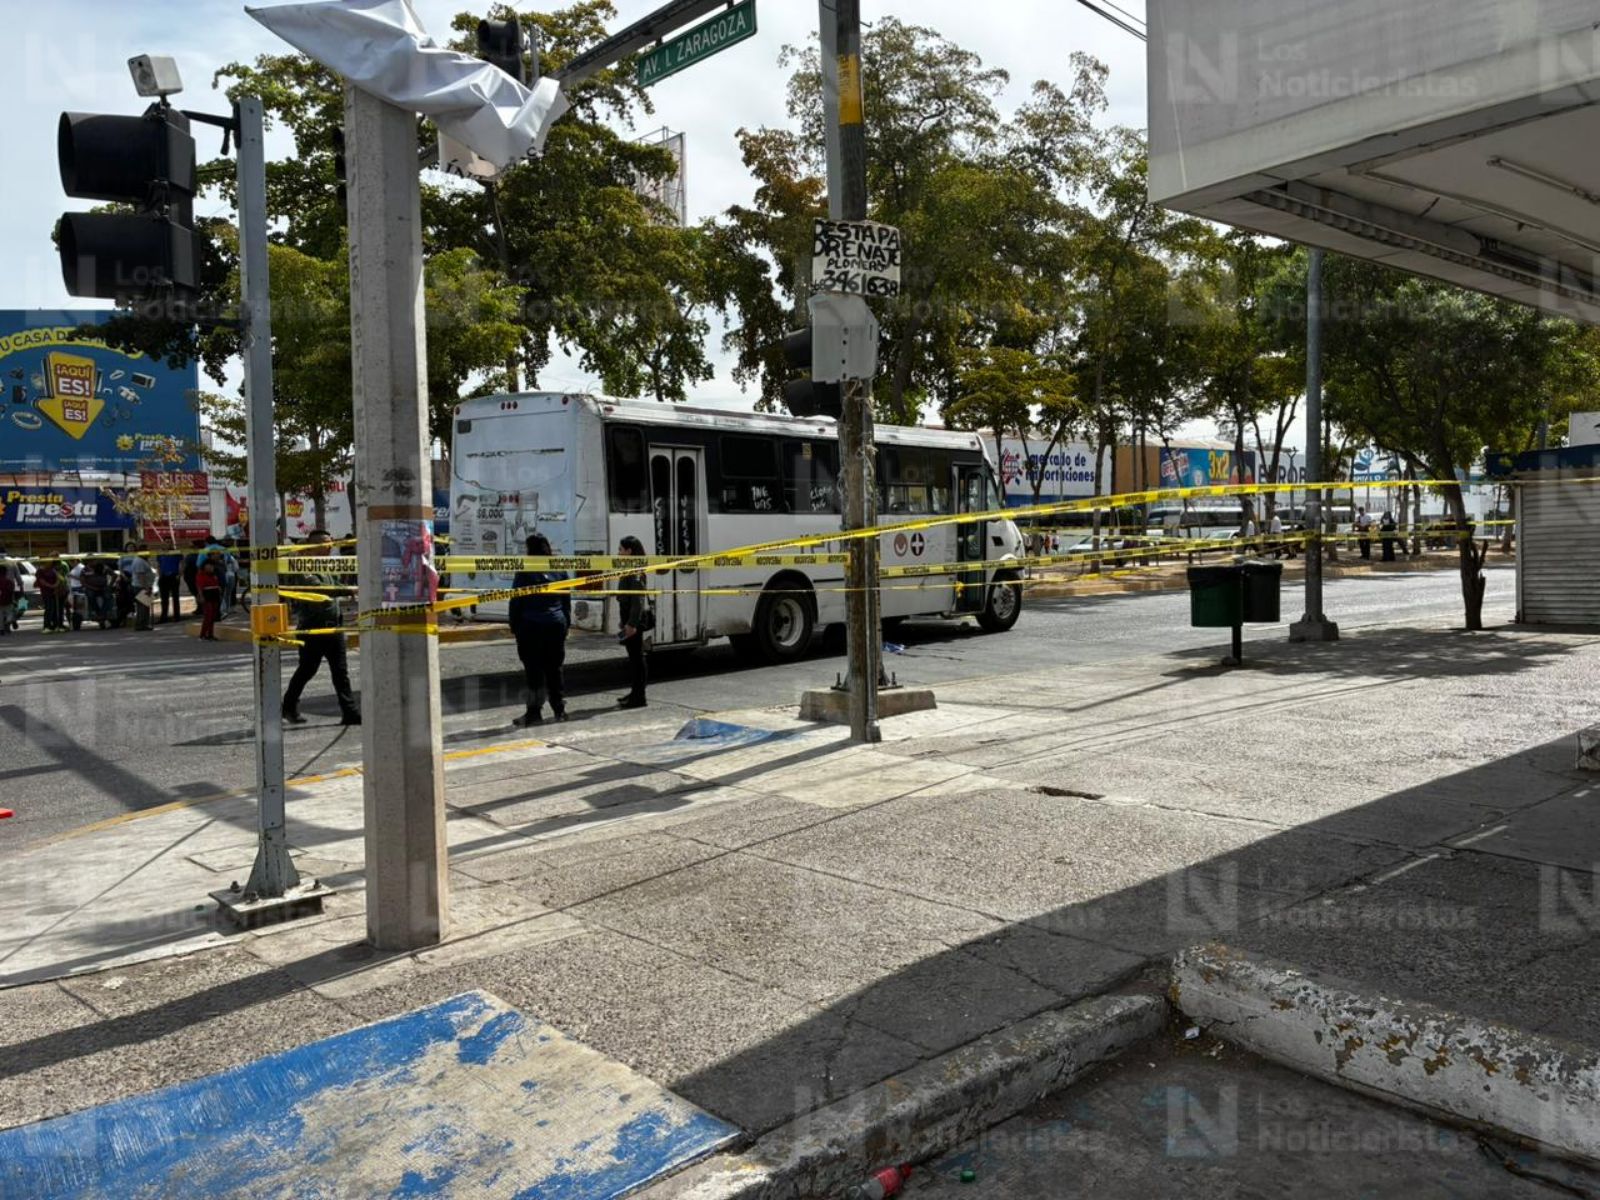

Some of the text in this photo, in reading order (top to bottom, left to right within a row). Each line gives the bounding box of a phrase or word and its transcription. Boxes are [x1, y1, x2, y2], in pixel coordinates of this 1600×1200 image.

[643, 54, 661, 79] AV.
[677, 10, 746, 61] ZARAGOZA
[13, 330, 52, 347] CASA
[58, 377, 91, 396] ES!
[64, 409, 87, 421] ES!
[1074, 452, 1087, 466] de
[7, 491, 64, 504] Presta
[16, 500, 98, 523] presta
[288, 558, 356, 572] PRECAUCION
[475, 558, 525, 571] PRECAUCION
[549, 558, 592, 570] PRECAUCION
